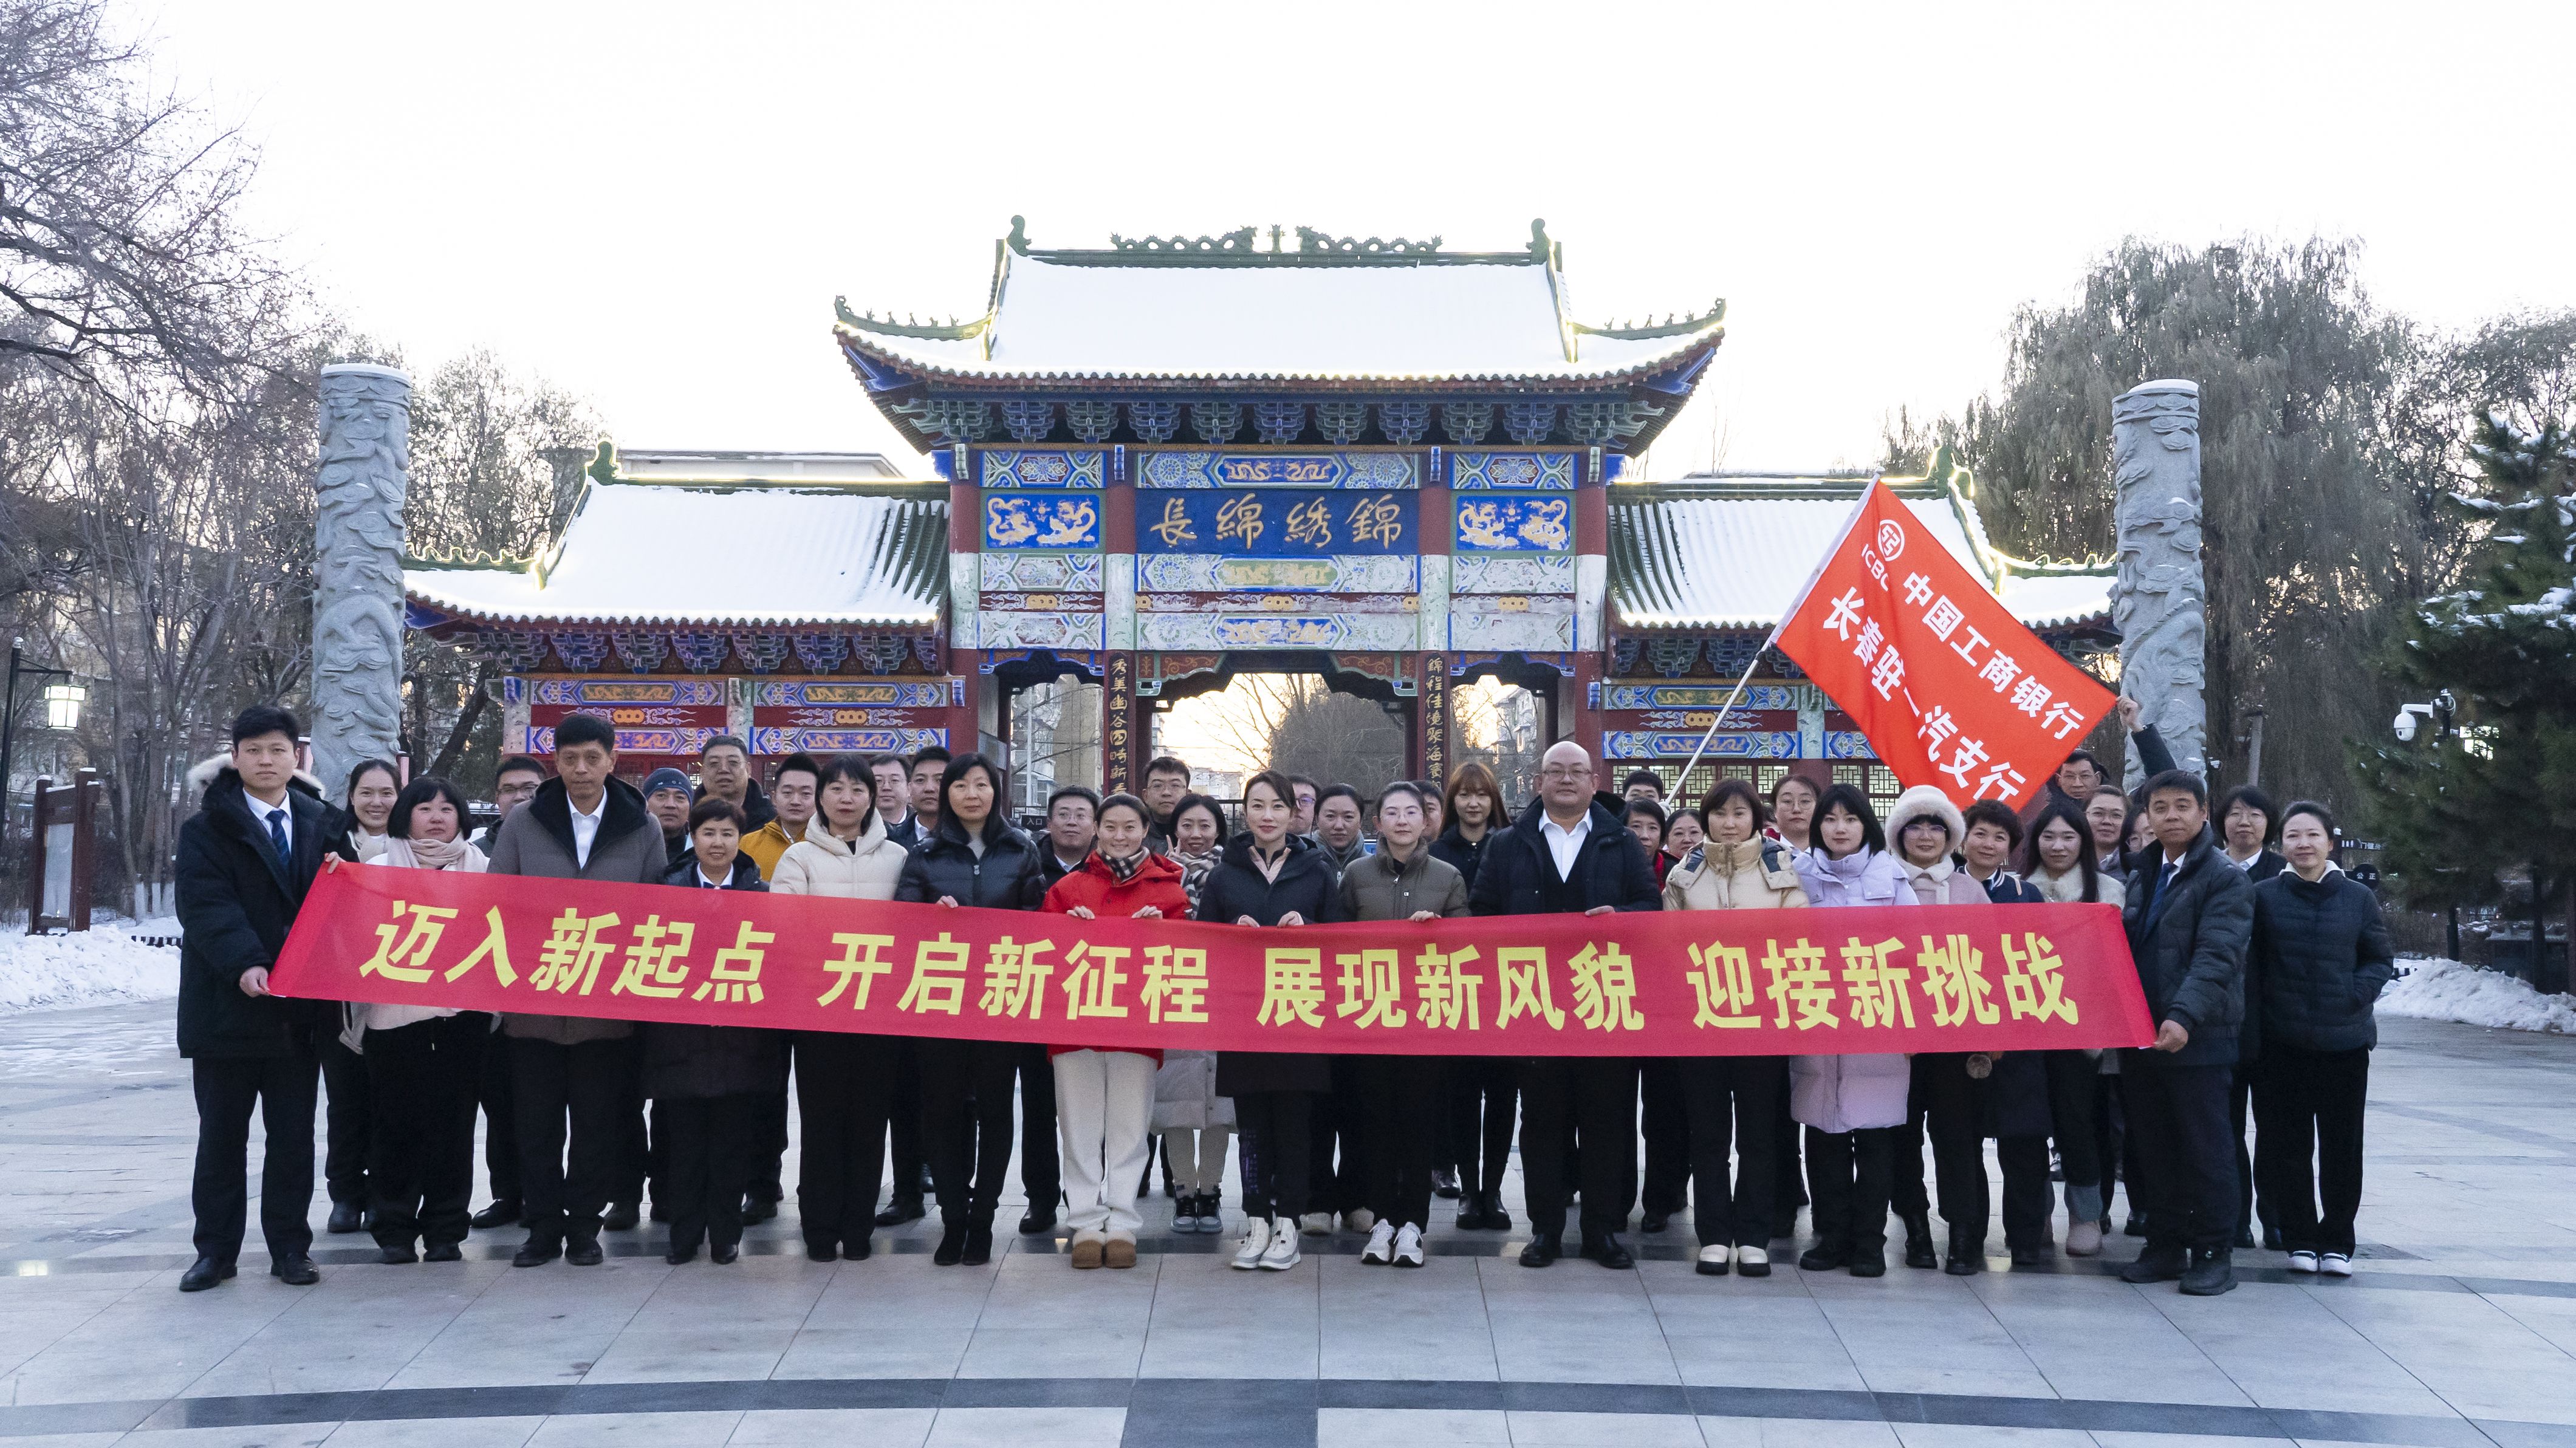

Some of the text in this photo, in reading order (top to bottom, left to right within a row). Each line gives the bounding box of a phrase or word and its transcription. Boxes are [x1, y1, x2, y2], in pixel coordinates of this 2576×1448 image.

[1823, 586, 2027, 802] 长春驻一汽支行
[1902, 571, 2085, 740] 中国工商银行
[1026, 818, 1043, 826] 入口
[358, 900, 2079, 1033] 迈入新起点 开启新征程 展现新风貌 迎接新挑战
